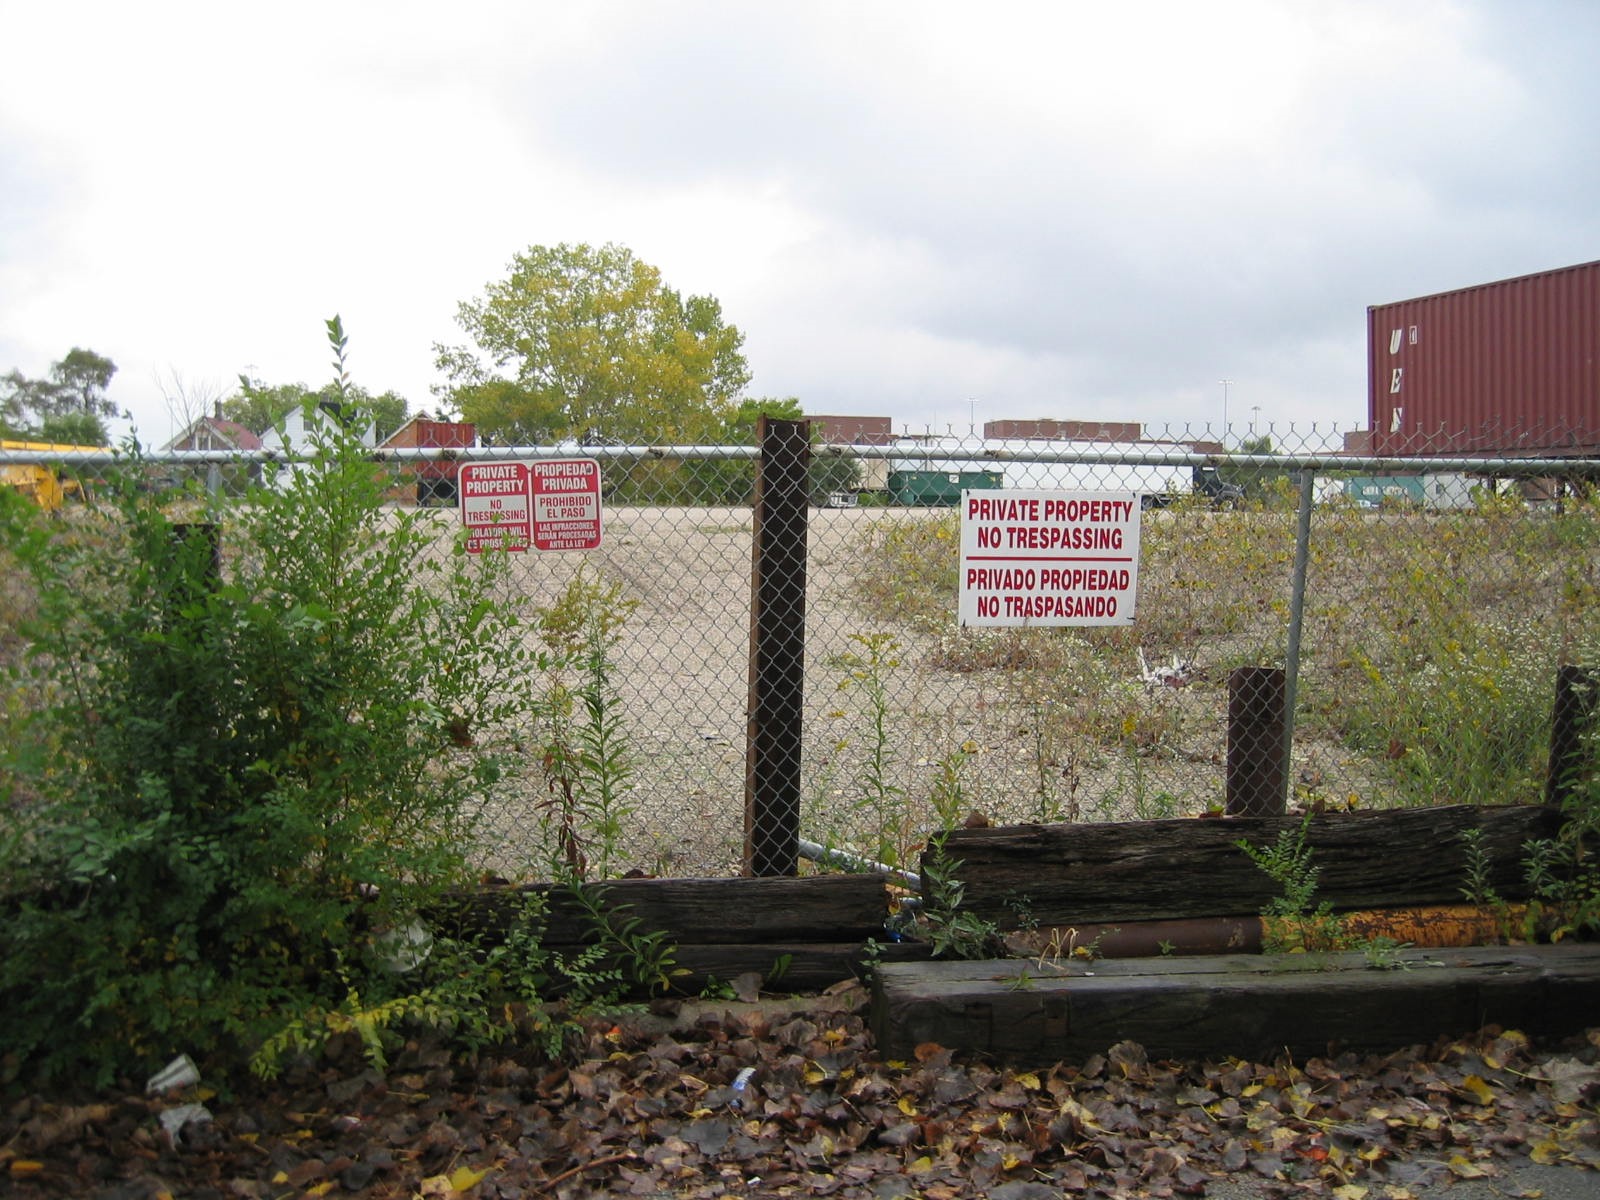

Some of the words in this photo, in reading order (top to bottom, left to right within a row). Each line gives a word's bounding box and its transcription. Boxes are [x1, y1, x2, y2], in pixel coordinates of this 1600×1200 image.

[472, 465, 517, 479] PRIVATE
[534, 463, 593, 477] PROPIEDAD
[466, 480, 524, 494] PROPERTY
[542, 478, 587, 491] PRIVADA
[490, 499, 502, 510] NO
[540, 496, 592, 508] PROHIBIDO
[547, 508, 558, 519] EL
[561, 507, 586, 518] PASO
[968, 499, 1039, 521] PRIVATE
[1044, 500, 1133, 522] PROPERTY
[469, 527, 508, 538] IOLATORS
[509, 525, 528, 536] WILL
[480, 537, 528, 549] PROSETED
[566, 540, 574, 548] LA
[575, 539, 586, 547] LEY
[977, 527, 1002, 549] NO
[1007, 527, 1123, 550] TRESPASSING
[967, 569, 1036, 590] PRIVADO
[1040, 569, 1130, 591] PROPIEDAD
[977, 596, 1000, 617] NO
[1004, 596, 1117, 618] TRASPASANDO
